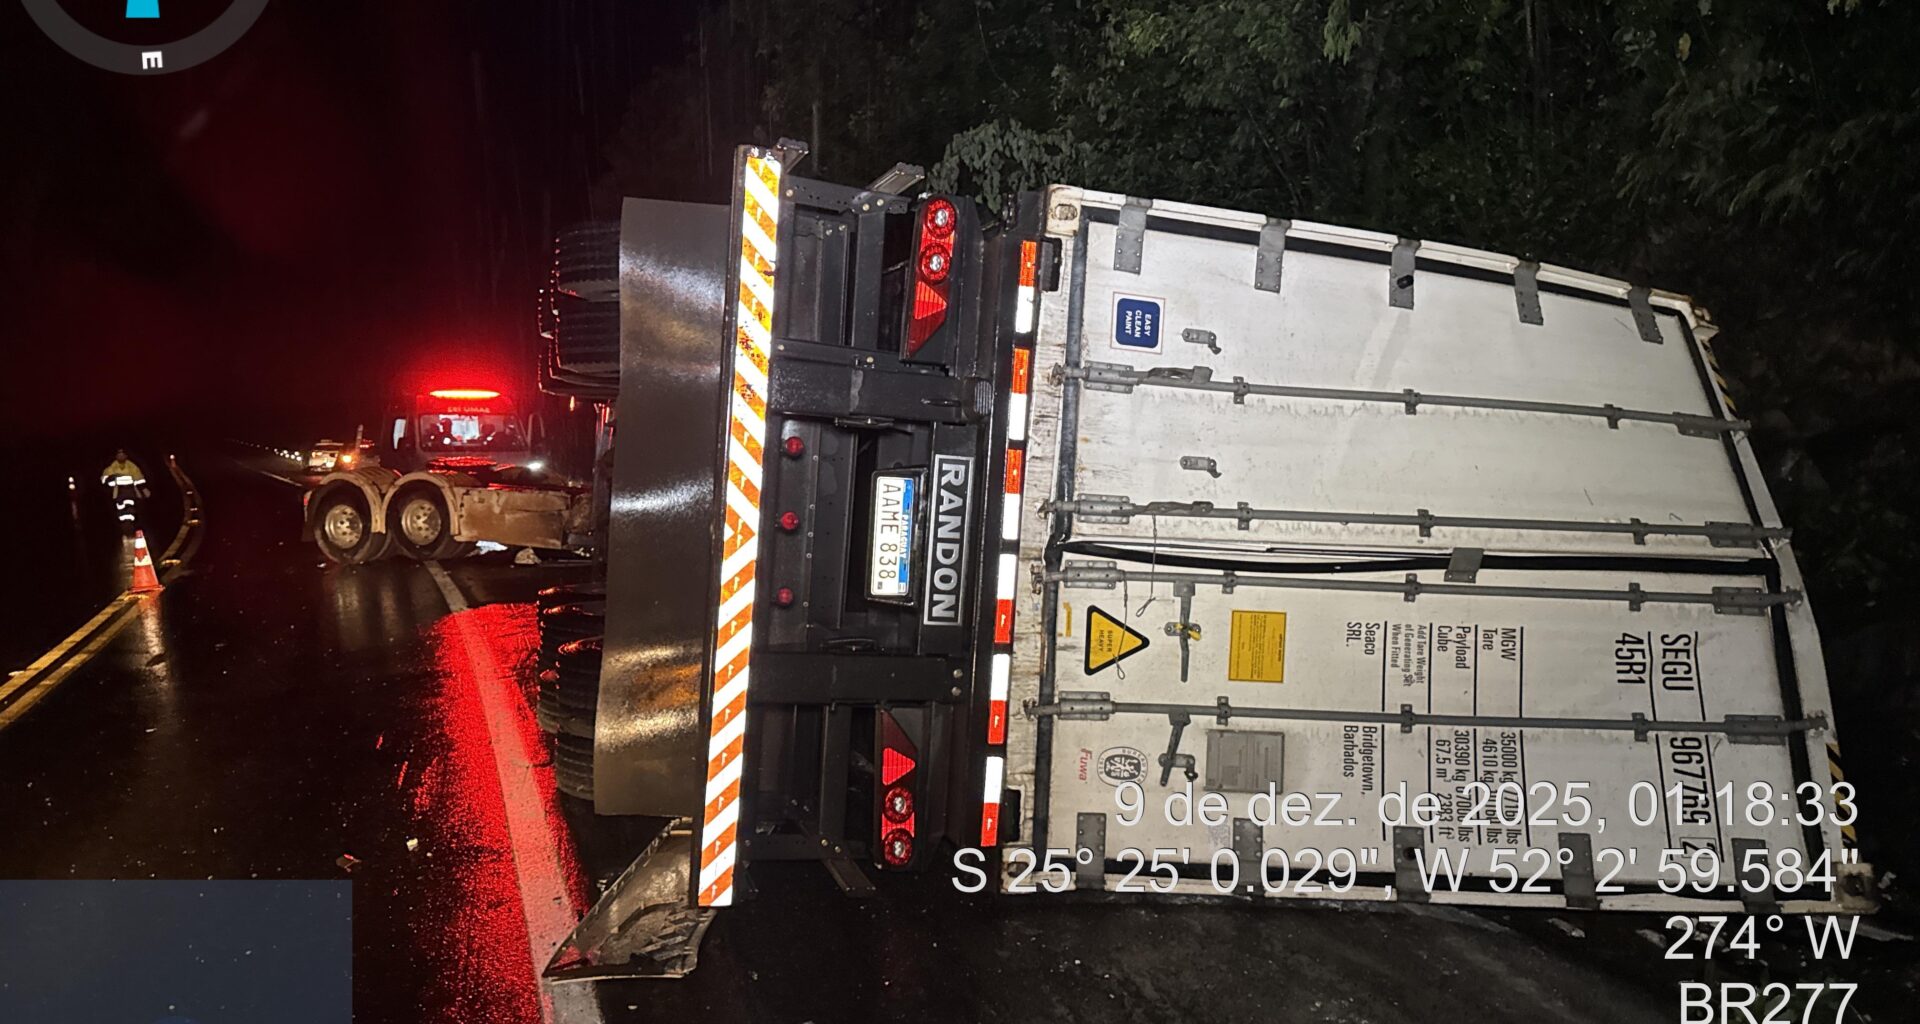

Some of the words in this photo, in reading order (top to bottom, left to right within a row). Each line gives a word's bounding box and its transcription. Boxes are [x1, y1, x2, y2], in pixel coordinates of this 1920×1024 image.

[881, 484, 901, 534] AAME
[900, 515, 909, 558] PARAGUAY
[932, 464, 966, 618] RANDON
[878, 543, 898, 579] 838
[1346, 622, 1362, 647] SRL.
[1364, 623, 1380, 655] Seaco
[1391, 624, 1401, 645] When
[1416, 625, 1426, 639] Add
[1437, 626, 1451, 652] Cube
[1482, 629, 1497, 650] Tare
[1501, 628, 1516, 661] MGW
[1391, 647, 1400, 668] Fitted
[1402, 633, 1413, 672] Generating
[1416, 641, 1425, 655] Tare
[1455, 626, 1470, 669] Payload
[1615, 633, 1646, 684] 45R1
[1660, 634, 1694, 691] SEGU
[1414, 657, 1426, 684] Weight
[1344, 725, 1359, 778] Barbados
[1358, 726, 1377, 795] Bridgetown,
[1436, 740, 1450, 764] 67.5
[1454, 730, 1469, 766] 30390
[1482, 738, 1498, 768] 4610
[1501, 732, 1517, 768] 35000
[1079, 748, 1092, 781] Fuwa
[1452, 770, 1470, 782] kg
[1480, 771, 1498, 783] kg
[1500, 771, 1519, 783] kg
[1671, 737, 1711, 824] 967769
[1436, 793, 1454, 822] 2383
[1458, 827, 1473, 842] lbs
[1486, 828, 1502, 843] lbs
[1507, 829, 1522, 845] lbs
